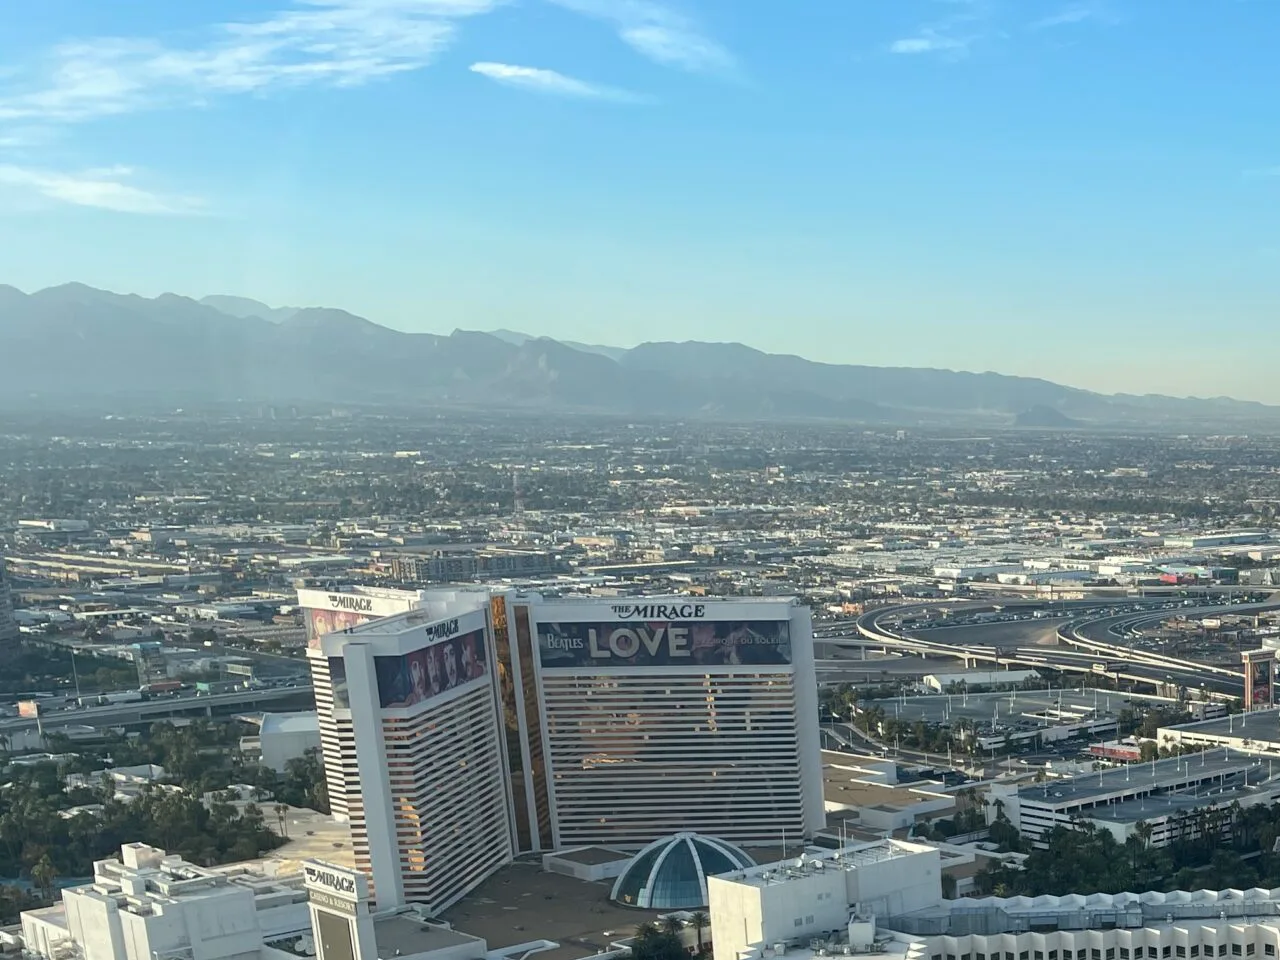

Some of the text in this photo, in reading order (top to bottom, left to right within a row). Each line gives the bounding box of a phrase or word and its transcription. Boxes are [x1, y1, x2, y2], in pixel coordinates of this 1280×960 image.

[332, 596, 373, 612] MIRAGE
[611, 604, 705, 620] THE MIRAGE
[429, 618, 459, 642] MIRAGE
[547, 633, 584, 652] BEATLES
[588, 628, 692, 659] LOVE
[310, 870, 355, 894] MIRAGE
